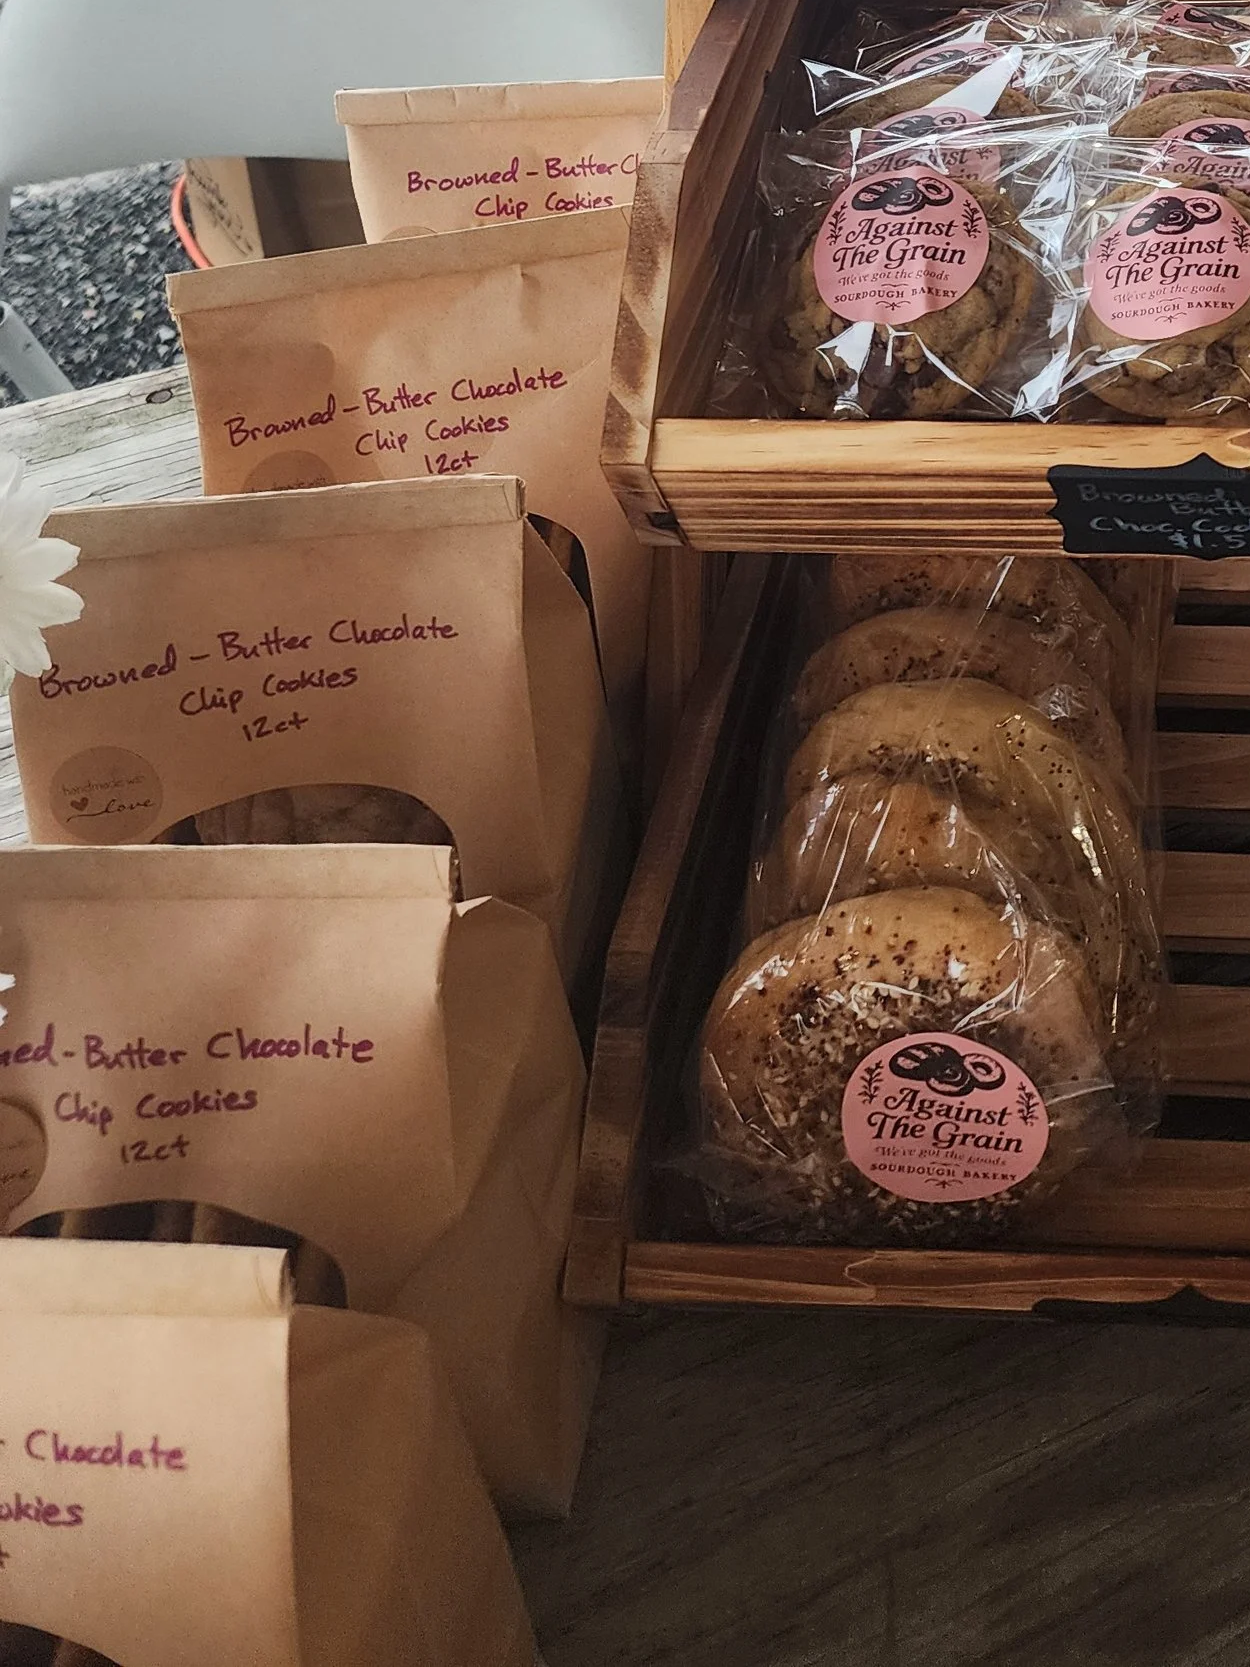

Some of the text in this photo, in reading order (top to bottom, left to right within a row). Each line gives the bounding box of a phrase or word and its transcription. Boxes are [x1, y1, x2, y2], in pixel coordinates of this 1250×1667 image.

[407, 157, 519, 193] Browned
[545, 154, 618, 179] Butter
[475, 192, 613, 220] Chip Cookies
[845, 216, 961, 245] Against
[832, 237, 967, 273] The Grain
[1118, 235, 1229, 263] Against
[871, 270, 892, 282] got
[894, 268, 913, 279] the
[915, 268, 951, 282] goods
[1105, 255, 1241, 291] The Grain
[833, 286, 959, 304] SOURDOUGH BAKERY
[1149, 287, 1168, 299] got
[1169, 283, 1189, 295] the
[1190, 283, 1226, 295] goods
[1111, 300, 1236, 320] SOURDOUGH BAKERY
[224, 393, 336, 448] Browned
[362, 382, 438, 417] Butter
[451, 367, 568, 402] Chocolate
[355, 415, 510, 457] Chip Cookies
[424, 451, 479, 475] 12ct
[1078, 484, 1228, 503] Browned
[1090, 517, 1183, 533] Choc.
[38, 644, 178, 700] Browned
[218, 626, 312, 663] Butter
[329, 613, 459, 645] Chocolate
[179, 665, 358, 717] Chip Cookies
[242, 714, 309, 743] 12ct
[84, 1034, 187, 1070] Butter
[207, 1023, 375, 1064] Chocolate
[54, 1088, 259, 1135] Chip Cookies
[884, 1087, 1013, 1126] Against
[867, 1111, 1024, 1154] The Grain
[119, 1135, 191, 1166] 12ct
[870, 1162, 1017, 1182] SOURDOUGH BAKERY
[24, 1428, 189, 1471] Chocolate
[0, 1491, 85, 1527] okies
